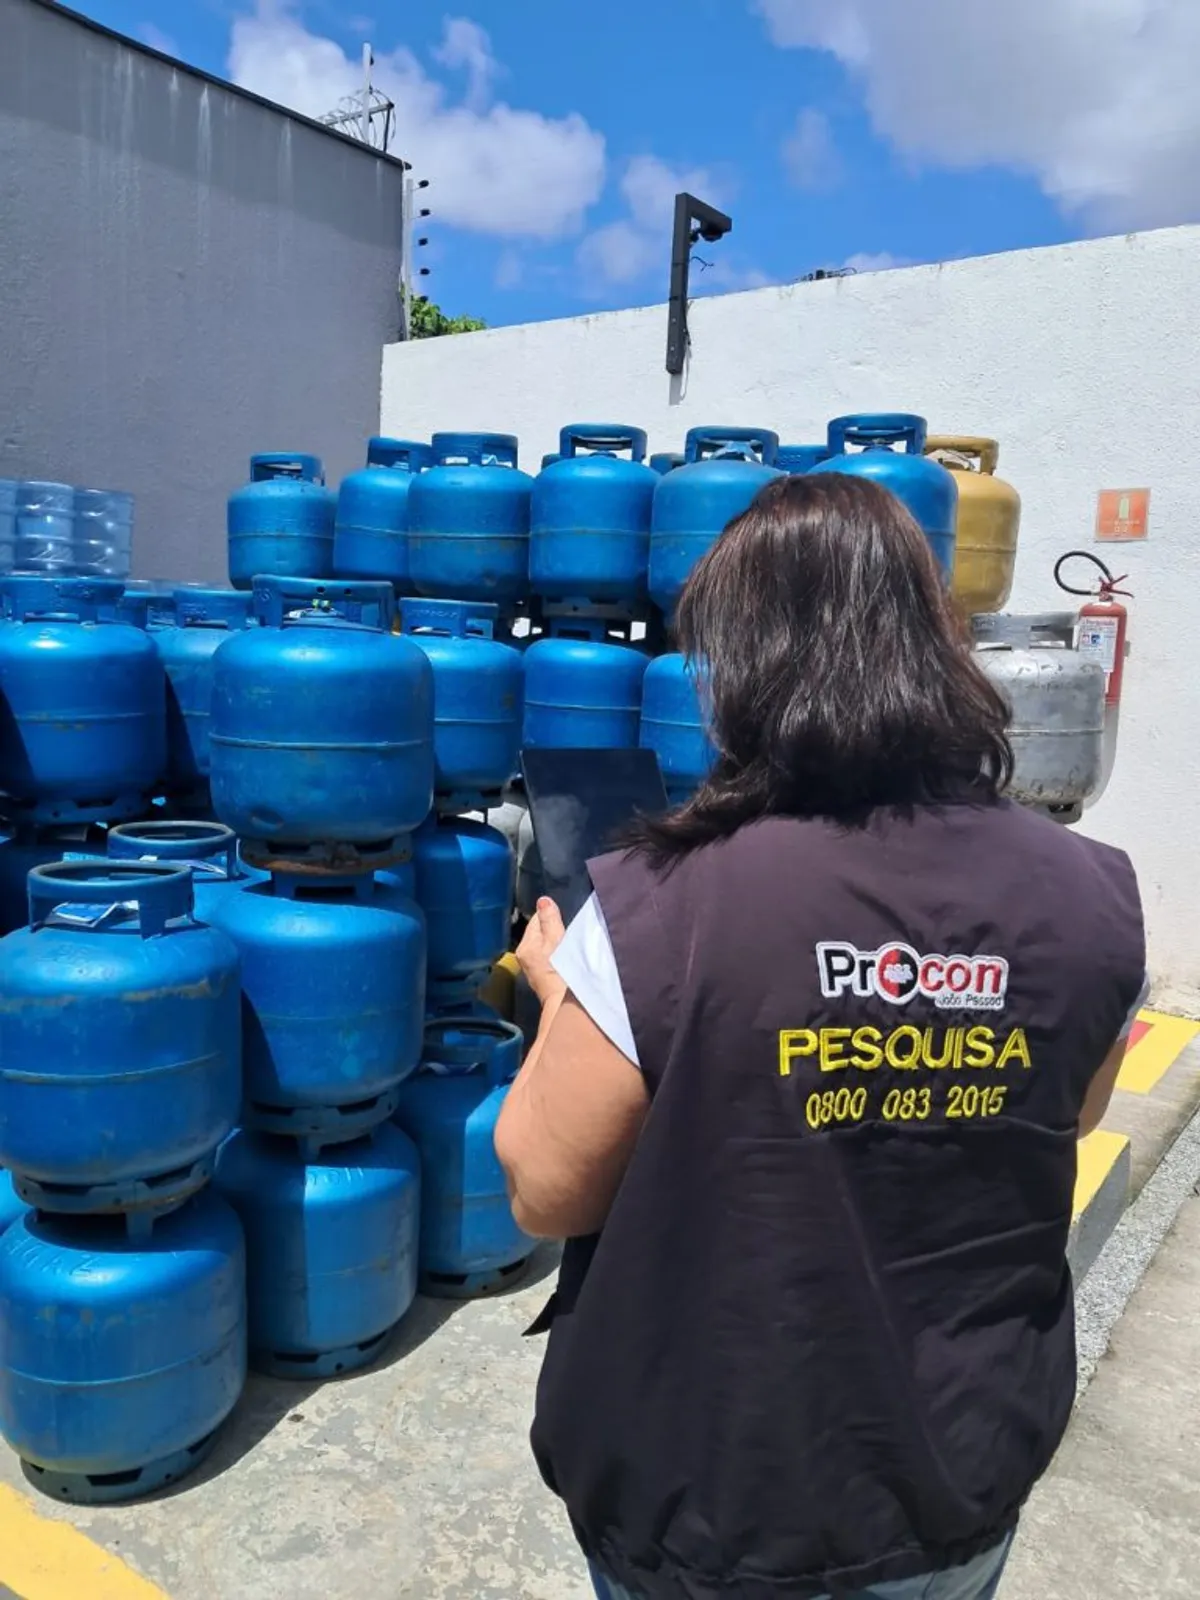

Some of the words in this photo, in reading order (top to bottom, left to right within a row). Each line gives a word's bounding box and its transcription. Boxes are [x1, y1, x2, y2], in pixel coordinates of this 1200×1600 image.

[822, 946, 1003, 999] Procon
[778, 1024, 1032, 1077] PESQUISA
[805, 1086, 867, 1129] 0800
[882, 1087, 931, 1121] 083
[945, 1085, 1008, 1119] 2015
